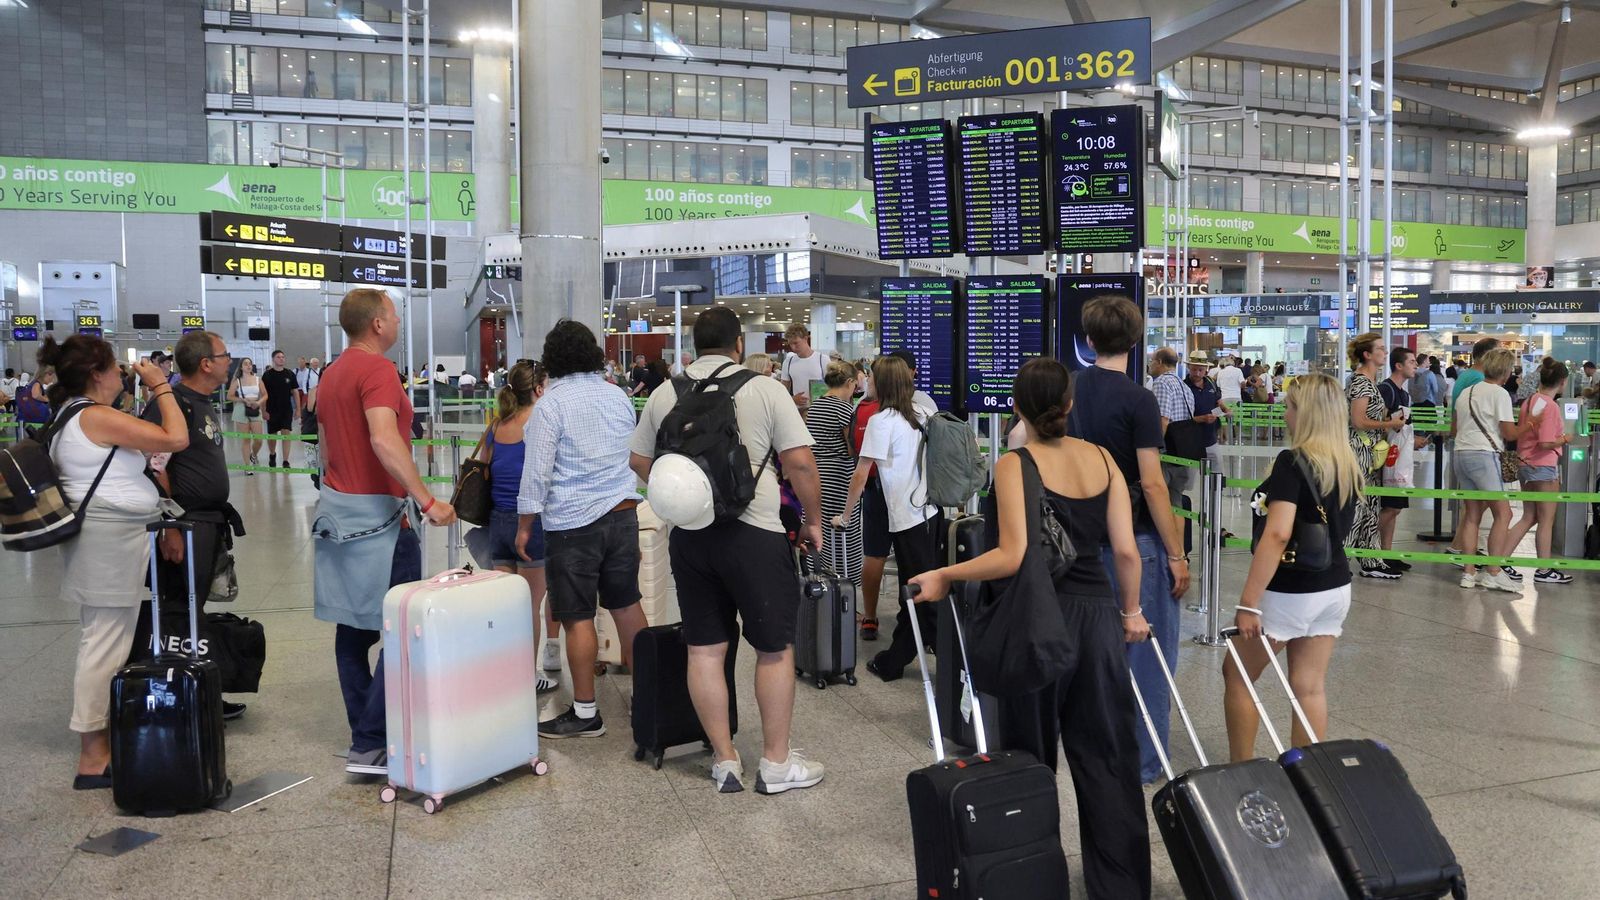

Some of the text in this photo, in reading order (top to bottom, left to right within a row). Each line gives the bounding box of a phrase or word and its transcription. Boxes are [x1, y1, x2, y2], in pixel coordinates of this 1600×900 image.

[927, 50, 983, 65] Abfertigung
[927, 65, 967, 78] Check-in
[1005, 49, 1135, 86] 001 to 362
[927, 71, 1073, 93] Facturación a
[1077, 135, 1115, 150] 10:08
[12, 165, 59, 181] años
[64, 168, 136, 187] contigo
[242, 184, 276, 193] aena
[13, 187, 64, 203] Years
[71, 189, 138, 209] Serving
[144, 191, 176, 207] You
[250, 195, 294, 203] Aeropuerto
[644, 188, 772, 208] 100 años contigo
[644, 207, 673, 221] 100
[1188, 215, 1212, 227] años
[1215, 217, 1254, 231] contigo
[1311, 229, 1331, 237] aena
[1216, 233, 1253, 248] Serving
[1255, 234, 1274, 247] You
[1539, 301, 1583, 310] GALLERY
[14, 317, 34, 325] 360
[80, 317, 99, 325] 361
[184, 317, 202, 326] 362
[984, 396, 997, 406] 06
